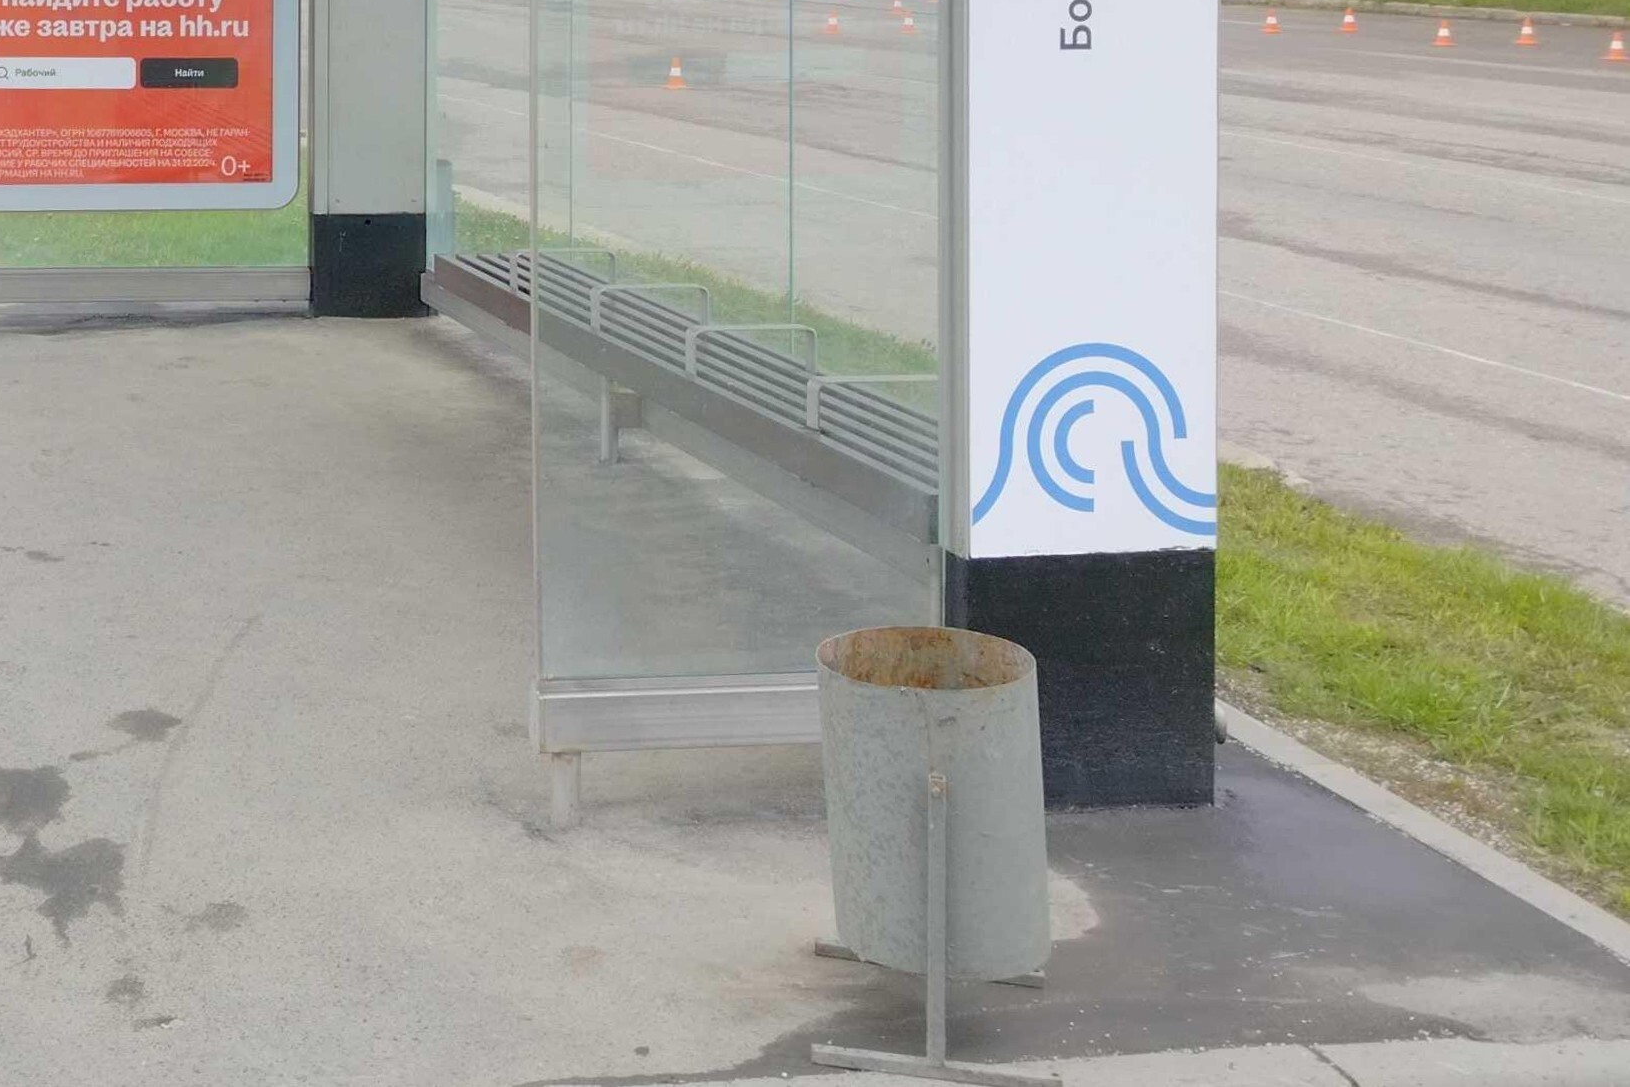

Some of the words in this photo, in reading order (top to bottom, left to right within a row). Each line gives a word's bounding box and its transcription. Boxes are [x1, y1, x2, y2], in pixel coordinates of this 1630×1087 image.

[36, 18, 133, 42] завтра
[139, 18, 174, 37] на
[178, 14, 250, 37] hh.ru
[14, 66, 57, 78] Рабочий
[174, 66, 205, 78] Найти
[60, 128, 85, 138] ОГРН
[164, 128, 204, 139] МОСКВА,
[207, 128, 219, 137] НЕ
[7, 139, 96, 149] ТРУДОУСТРОЙСТВА
[97, 139, 104, 148] И
[106, 139, 151, 148] НАЛИЧИЯ
[152, 139, 218, 148] ПОДХОДЯЩИХ
[41, 149, 72, 158] ВРЕМЯ
[73, 149, 88, 159] ДО
[89, 149, 159, 158] ПРИГЛАШЕНИЯ
[160, 149, 173, 157] НА
[25, 159, 67, 168] РАБОЧИХ
[68, 158, 156, 169] СПЕЦИАЛЬНОСТЕЙ
[158, 159, 171, 167] НА
[220, 155, 251, 176] 0+
[39, 170, 53, 178] НА
